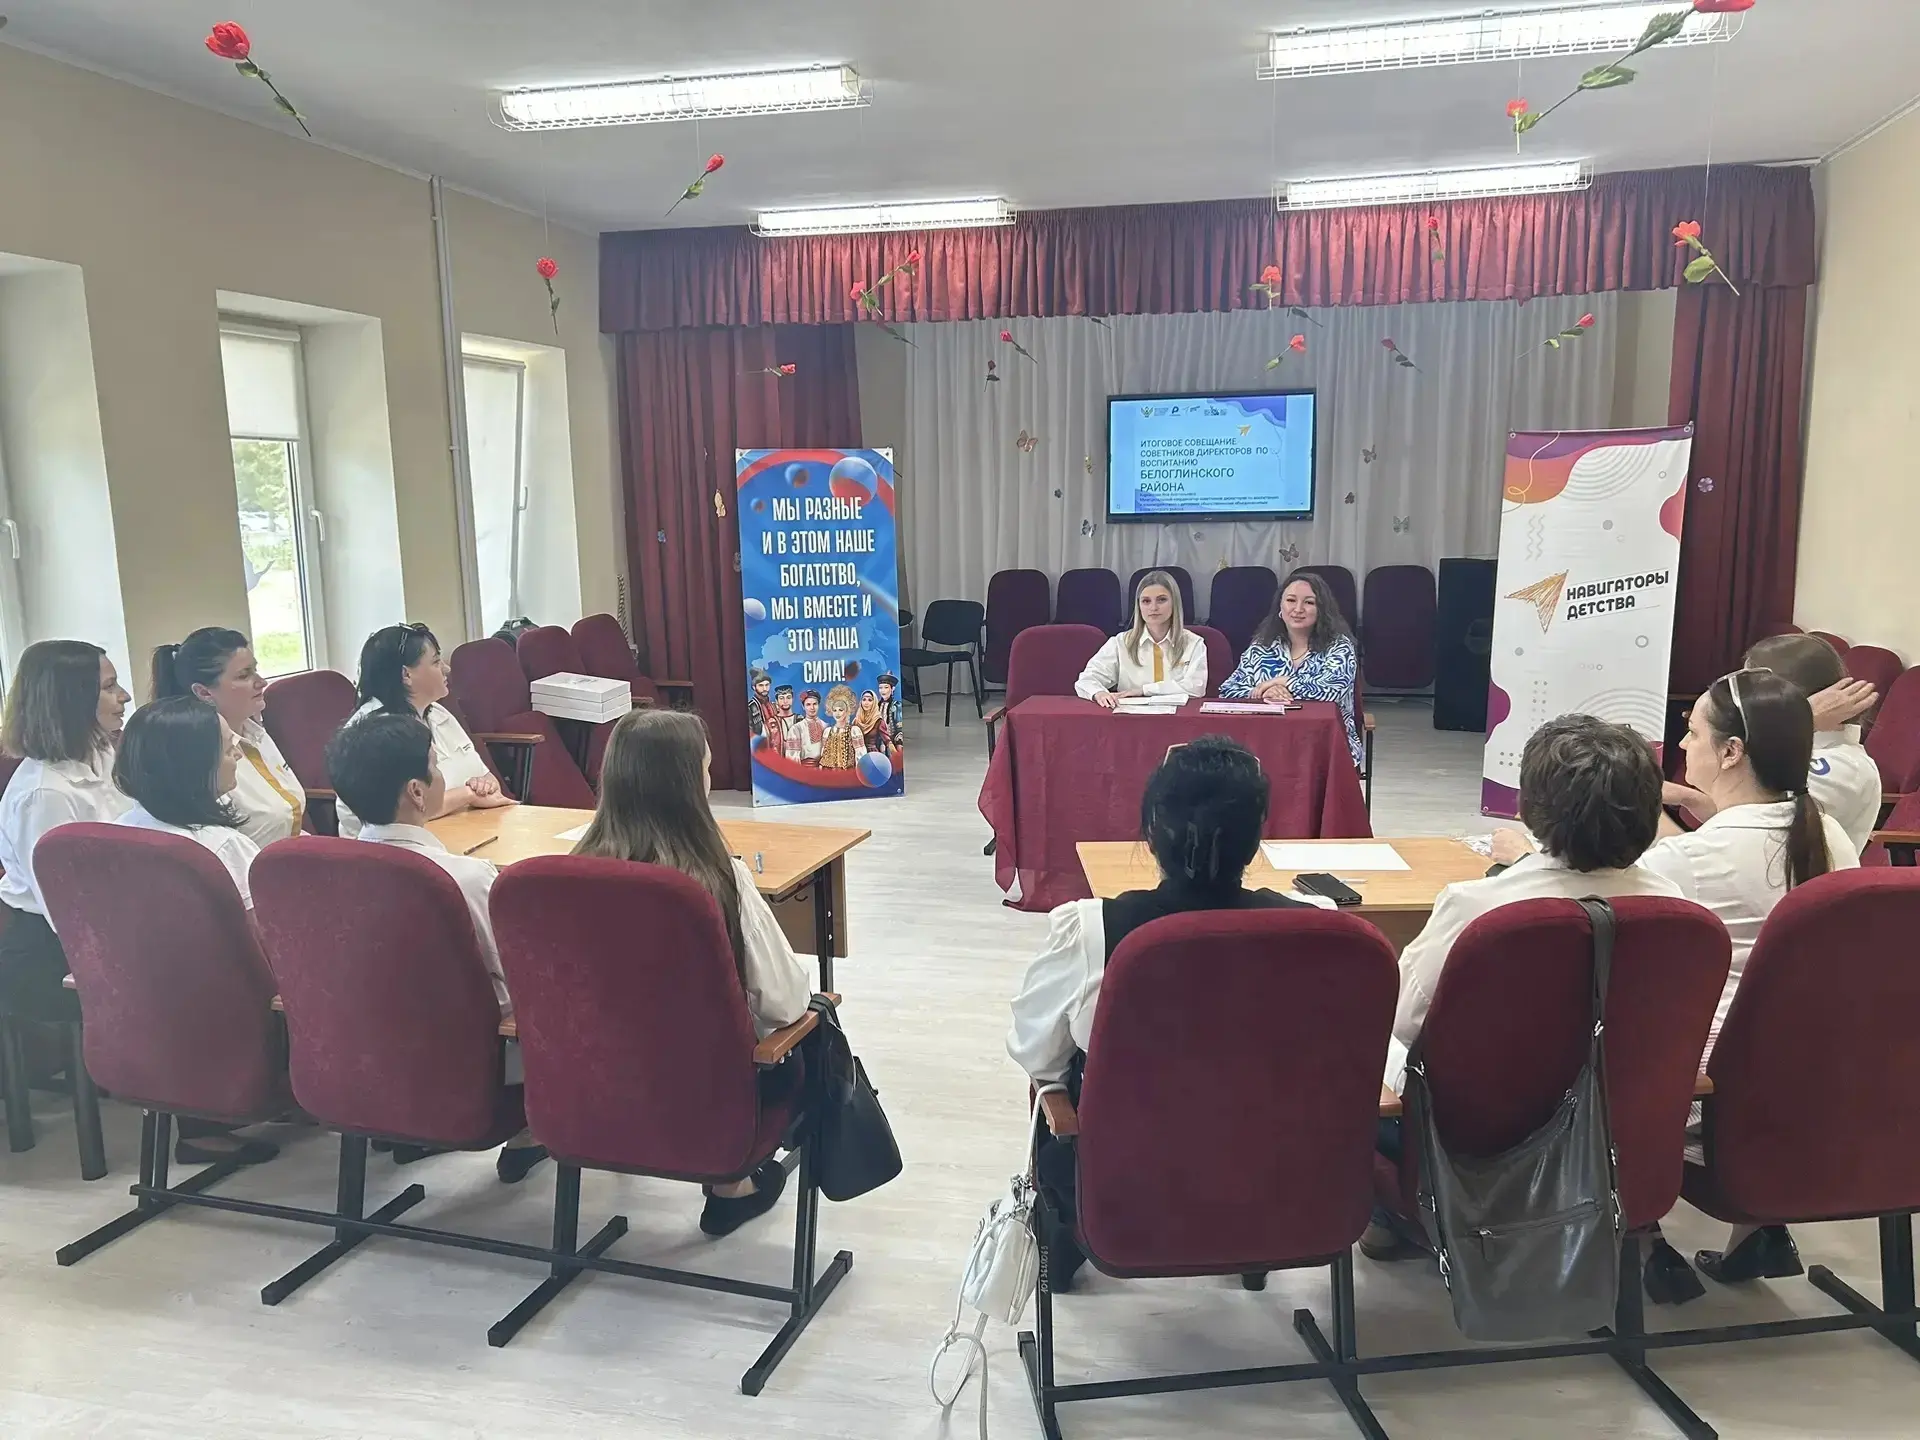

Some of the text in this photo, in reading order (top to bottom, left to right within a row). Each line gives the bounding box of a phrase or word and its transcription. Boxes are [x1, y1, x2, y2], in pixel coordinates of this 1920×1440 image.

[1140, 437, 1237, 448] ИТОГОВОЕ СОВЕЩАНИЕ
[1140, 446, 1269, 458] СОВЕТНИКОВ ДИРЕКТОРОВ ПО
[1140, 458, 1198, 468] ВОСПИТАНИЮ
[1140, 467, 1235, 479] БЕЛОГЛИНСКОГО
[1140, 480, 1185, 492] РАЙОНА
[772, 496, 863, 521] МЫ РАЗНЫЕ
[762, 529, 876, 555] И В ЭТОМ НАШЕ
[780, 562, 861, 588] БОГАТСТВО,
[1566, 570, 1669, 601] НАВИГАТОРЫ
[770, 593, 872, 621] МЫ ВМЕСТЕ И
[1566, 594, 1636, 621] ДЕТСТВА
[787, 626, 859, 652] ЭТО НАША
[803, 659, 846, 684] СИЛА!
